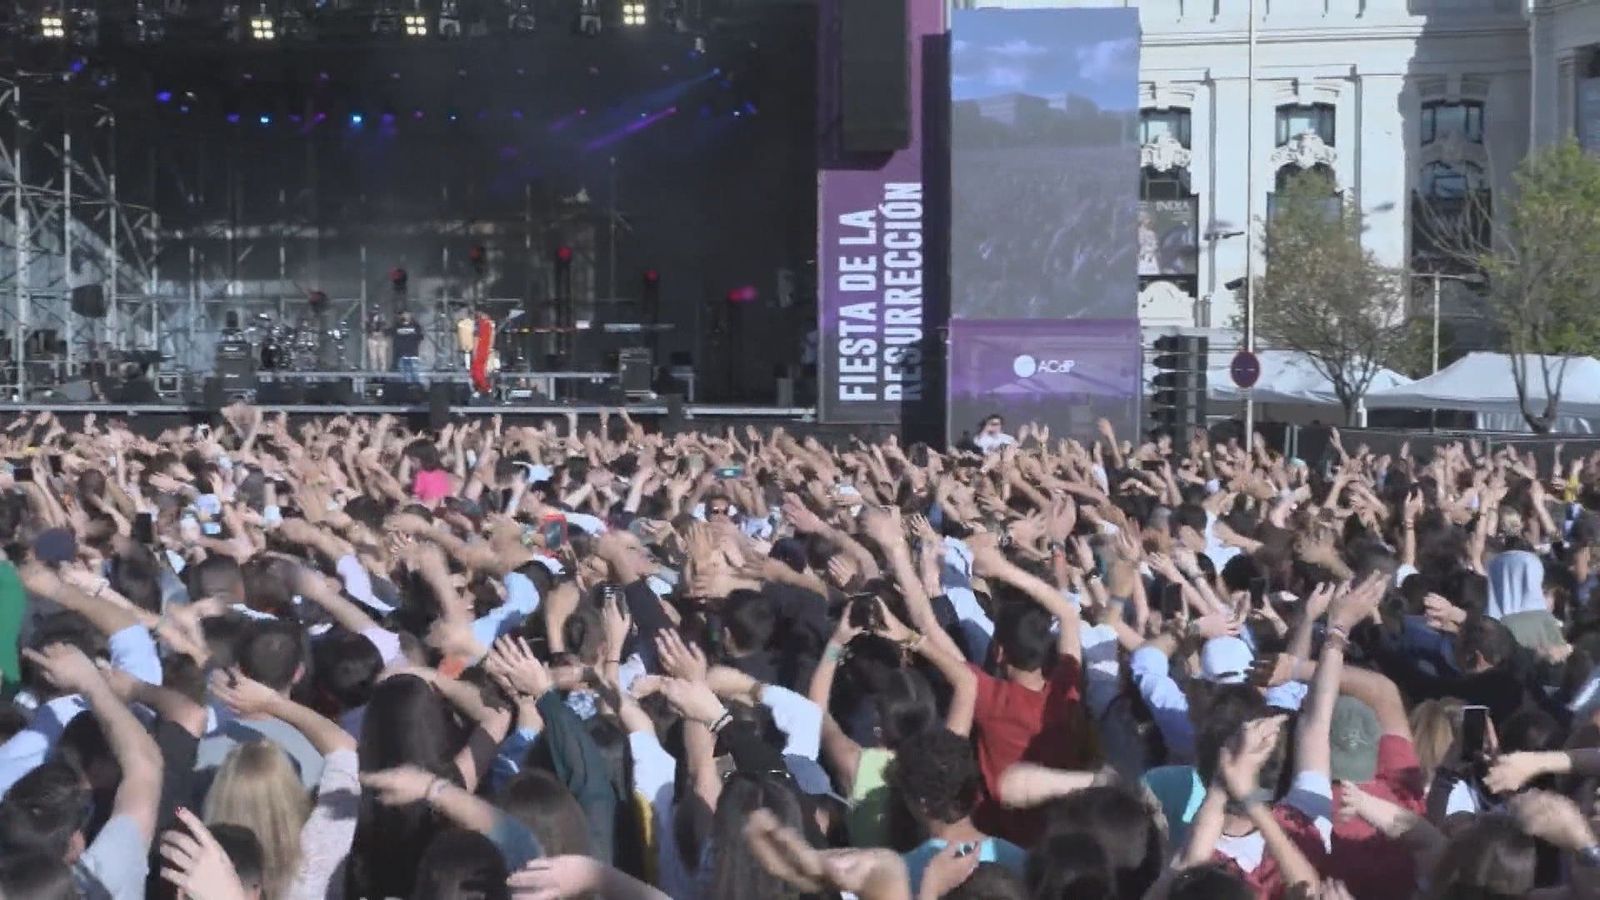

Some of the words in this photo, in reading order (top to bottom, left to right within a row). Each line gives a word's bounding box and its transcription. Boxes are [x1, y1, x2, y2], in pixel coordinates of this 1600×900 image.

[838, 209, 876, 244] LA
[838, 256, 876, 291] DE
[879, 182, 923, 401] RESURRECCIÓN
[838, 302, 876, 401] FIESTA
